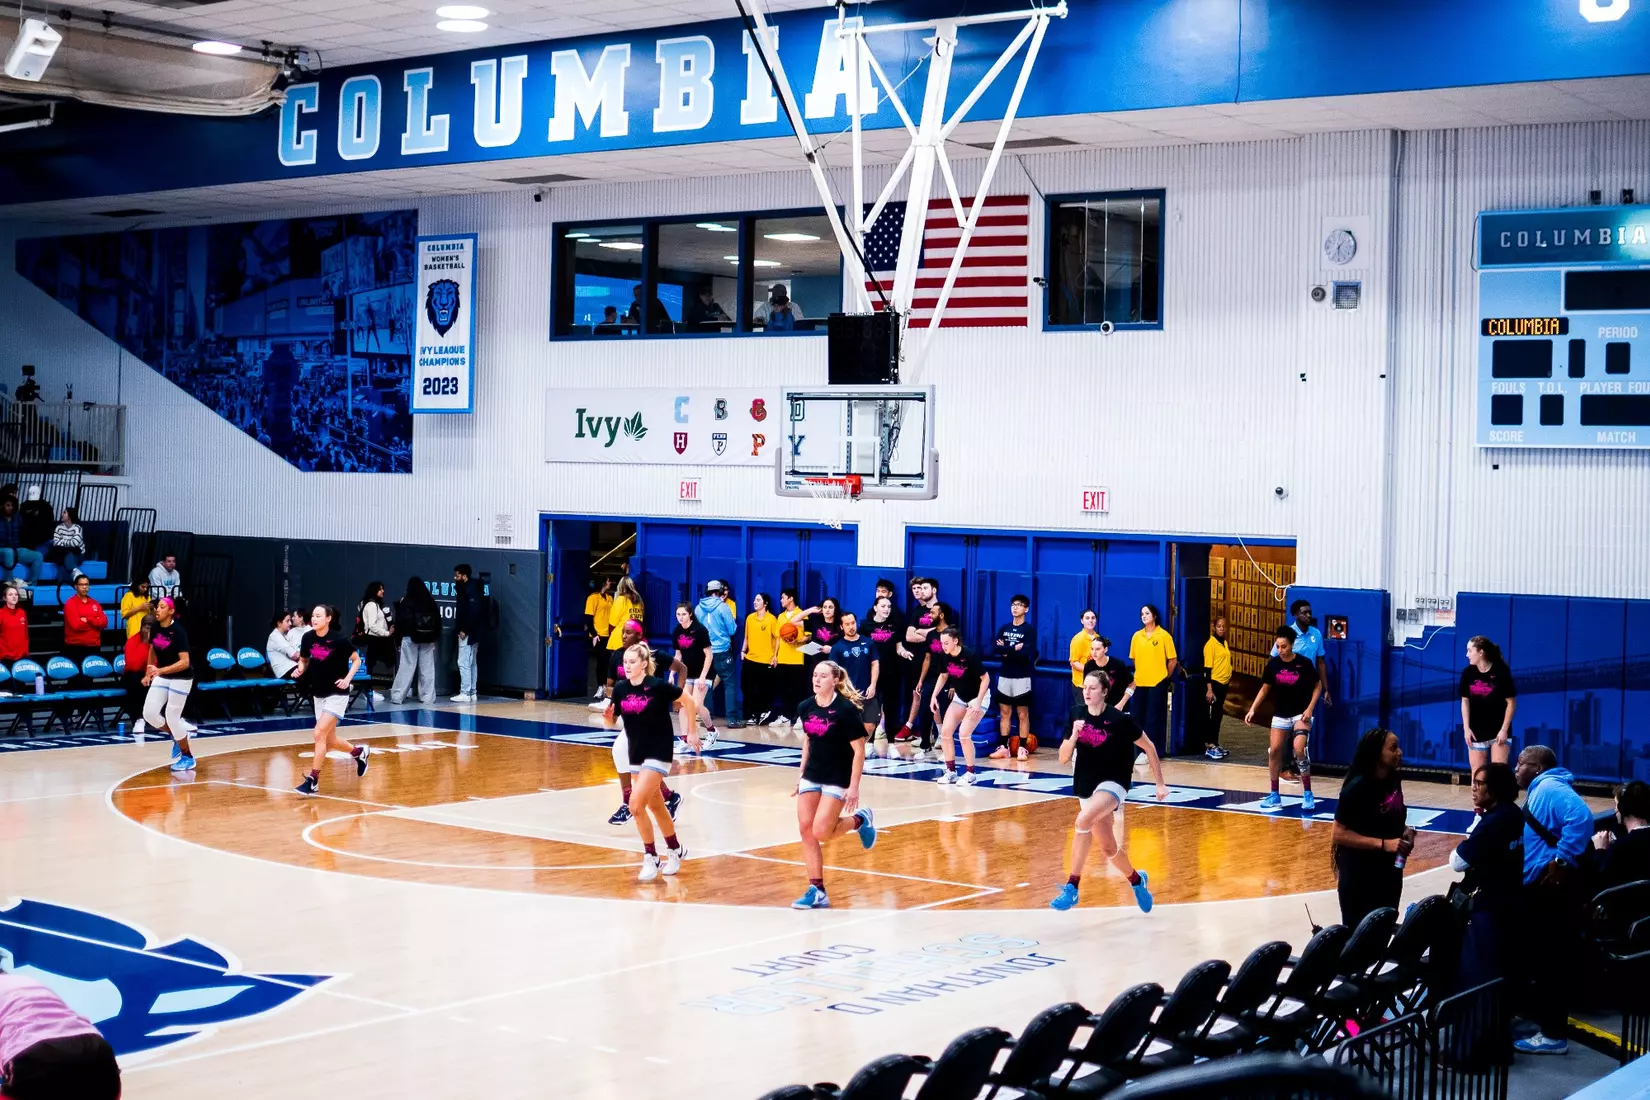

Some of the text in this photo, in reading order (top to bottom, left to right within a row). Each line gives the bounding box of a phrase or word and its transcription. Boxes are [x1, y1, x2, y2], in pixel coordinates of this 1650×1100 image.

[277, 16, 880, 168] COLUMBIA
[1500, 226, 1648, 248] COLUMBIA
[427, 243, 465, 251] COLUMBIA
[424, 262, 465, 270] BASKETBALL
[431, 255, 459, 263] WOMEN'S
[1488, 318, 1560, 335] COLUMBIA
[1598, 326, 1638, 338] PERIOD
[420, 346, 465, 355] IVY LEAGUE
[419, 357, 465, 366] CHAMPIONS
[423, 377, 458, 395] 2023
[1491, 382, 1526, 394] FOULS
[1580, 382, 1622, 393] PLAYER
[674, 396, 690, 424] C
[574, 408, 622, 448] Ivy
[1489, 430, 1636, 443] SCORE MATCH
[676, 434, 686, 448] H
[751, 433, 805, 456] P Y
[680, 481, 698, 499] EXIT
[1083, 491, 1105, 511] EXIT
[731, 944, 877, 978] COURT
